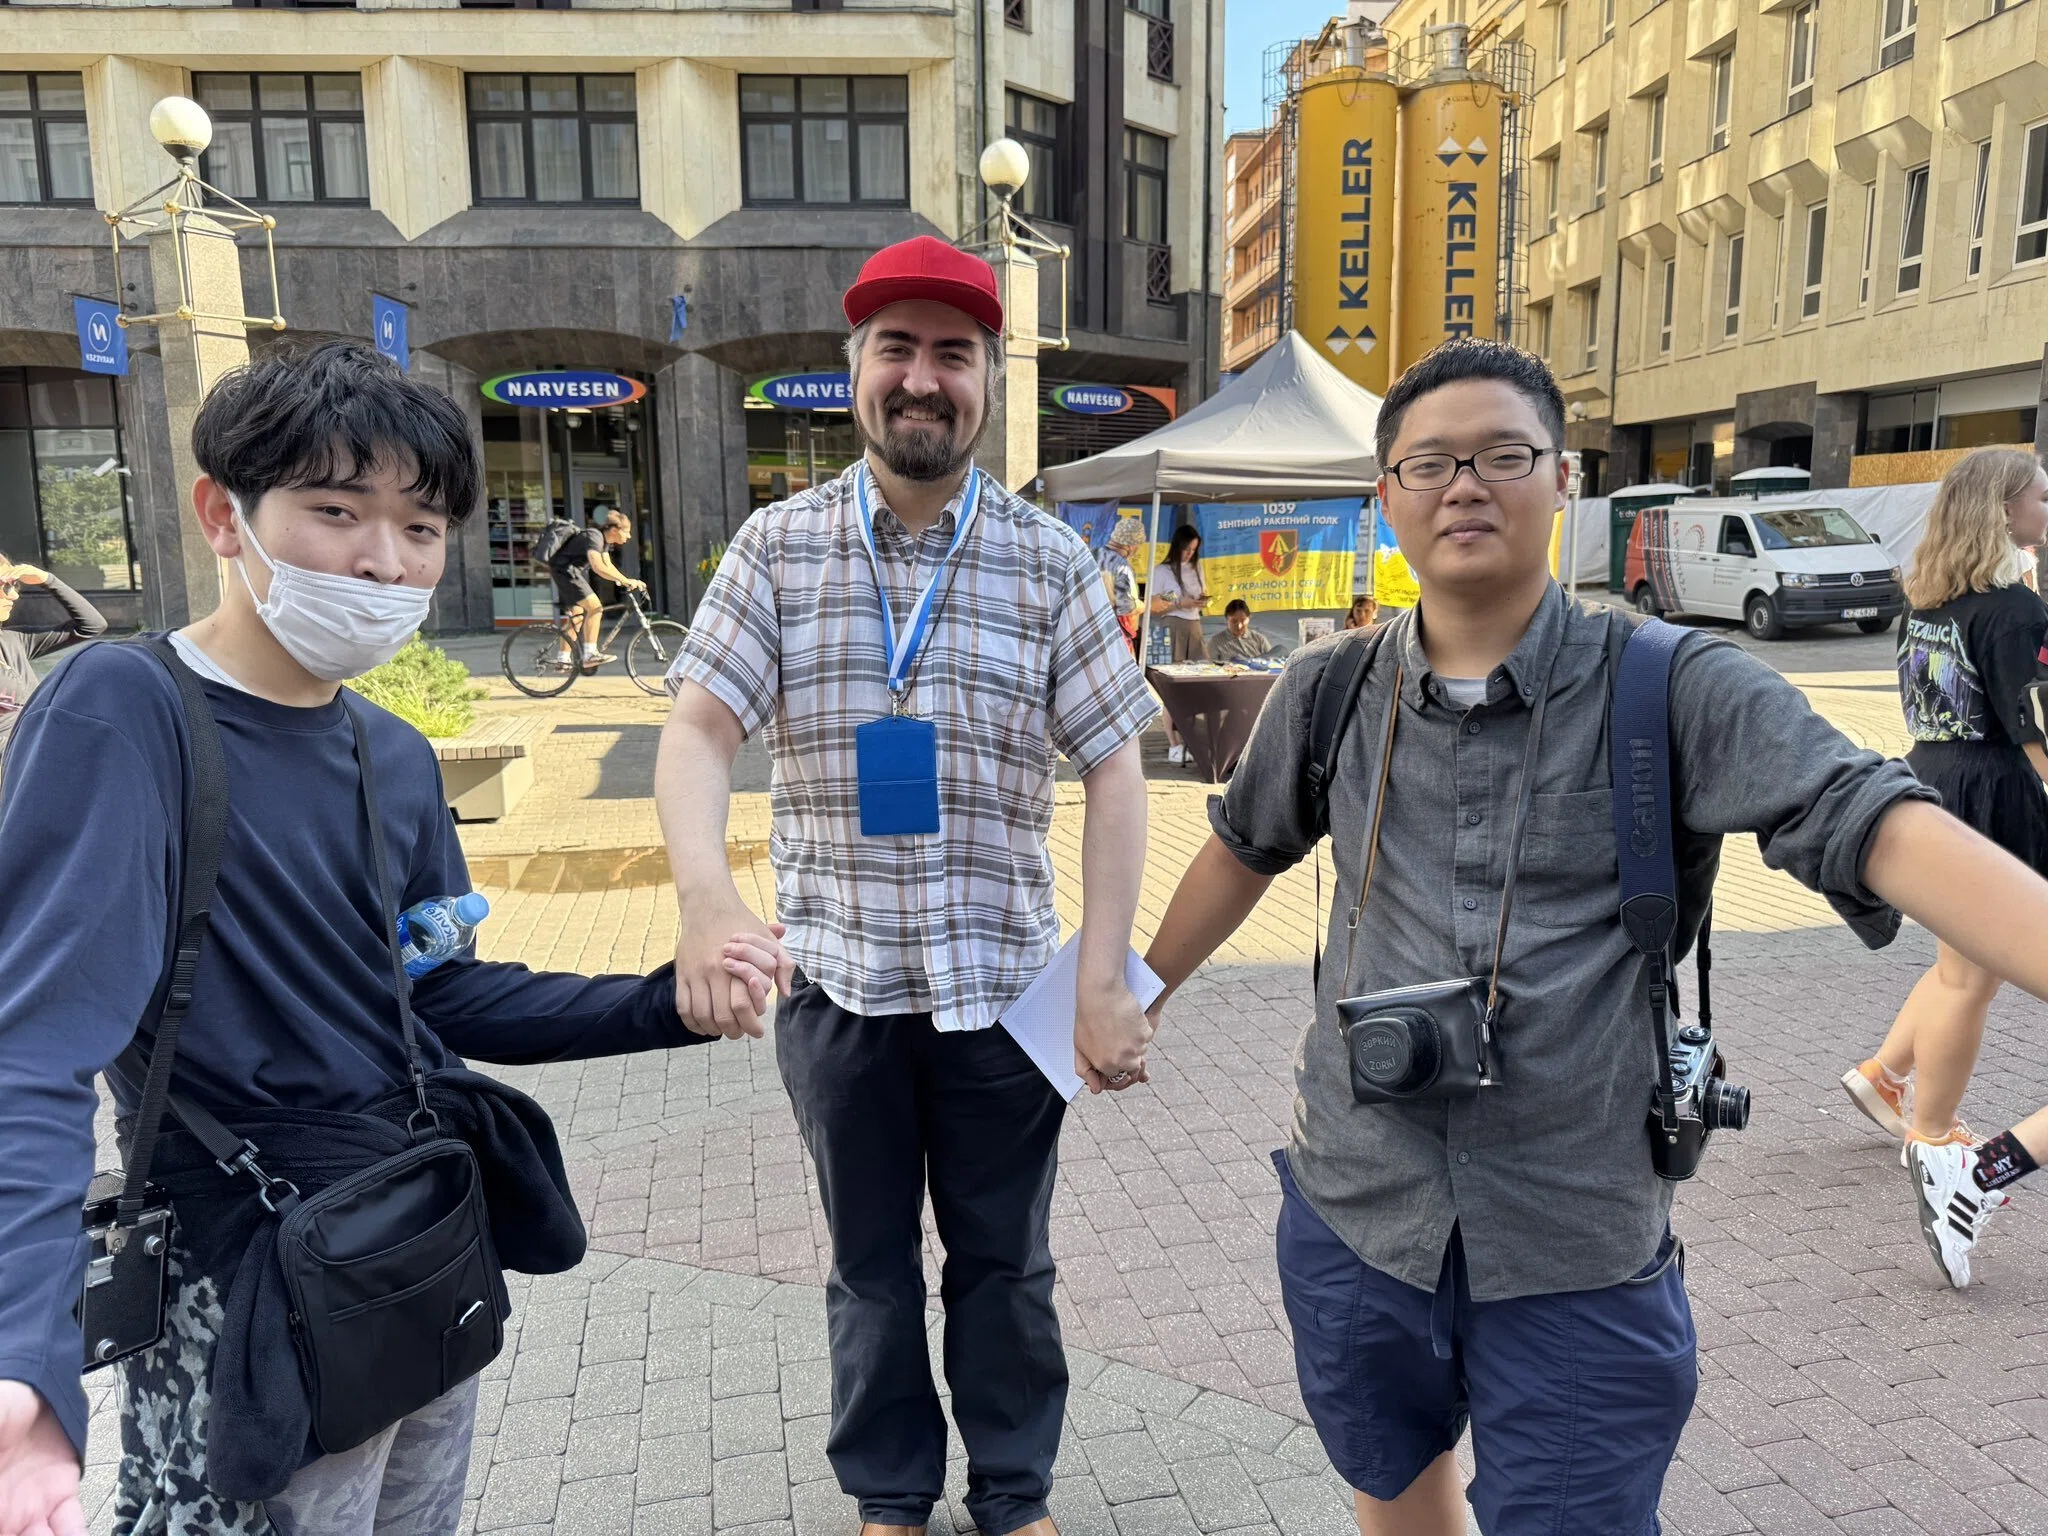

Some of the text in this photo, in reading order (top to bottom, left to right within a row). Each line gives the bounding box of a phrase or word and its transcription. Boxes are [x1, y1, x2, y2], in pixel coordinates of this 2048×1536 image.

[1338, 138, 1373, 309] KELLER
[1443, 182, 1477, 341] KELLER
[507, 381, 620, 397] NARVESEN
[775, 383, 854, 398] NARVES
[1067, 391, 1122, 407] NARVESEN
[1262, 502, 1297, 515] 1039
[1217, 514, 1339, 530] ЗЕНІТНИЙ РАКЕТНИЙ ПОЛК
[1369, 1056, 1396, 1071] ZORKI
[1992, 1155, 2014, 1174] MY
